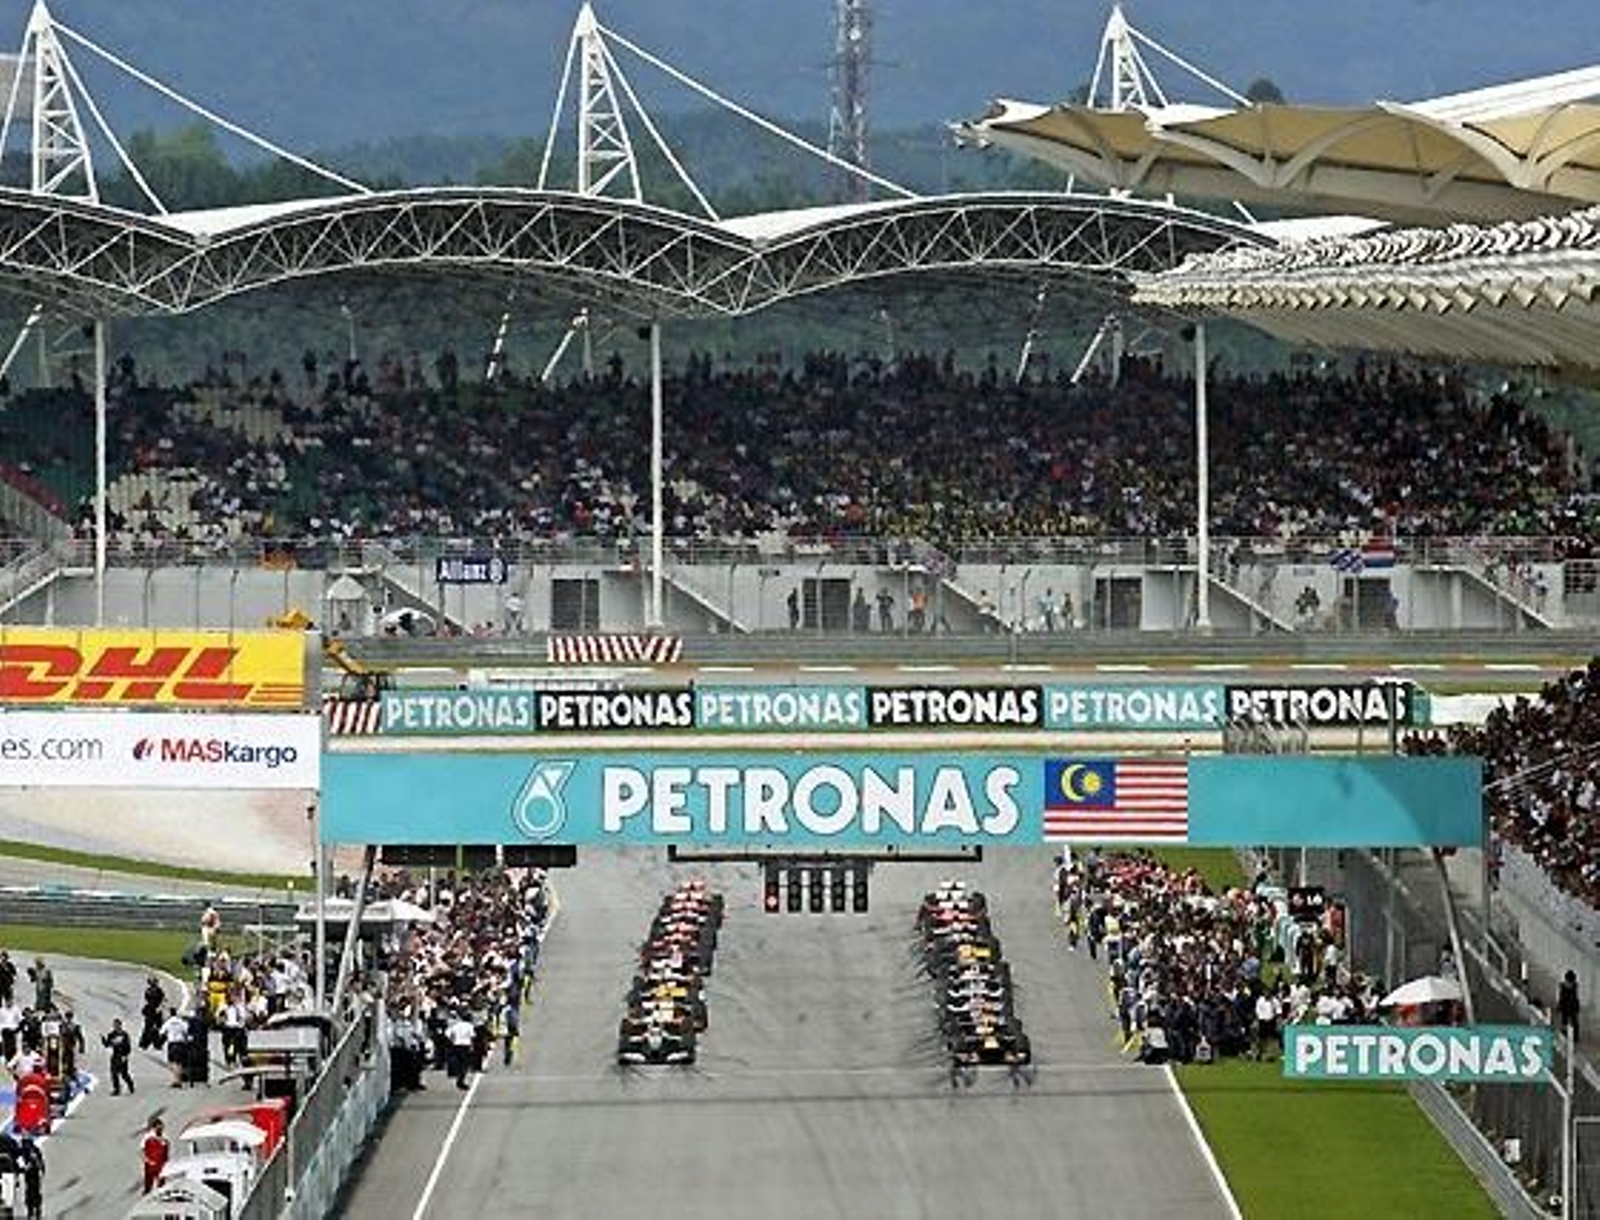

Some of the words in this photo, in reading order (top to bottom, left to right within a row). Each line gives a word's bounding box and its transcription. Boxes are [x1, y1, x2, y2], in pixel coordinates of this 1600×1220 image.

[440, 560, 487, 580] Allianz
[0, 644, 255, 700] DHL
[386, 693, 530, 728] PETRONAS
[541, 693, 692, 727] PETRONAS
[701, 692, 861, 725] PETRONAS
[873, 690, 1037, 723] PETRONAS
[1050, 689, 1218, 724] PETRONAS
[161, 739, 298, 768] MASkargo
[602, 765, 1021, 836] PETRONAS
[1295, 1033, 1543, 1076] PETRONAS
